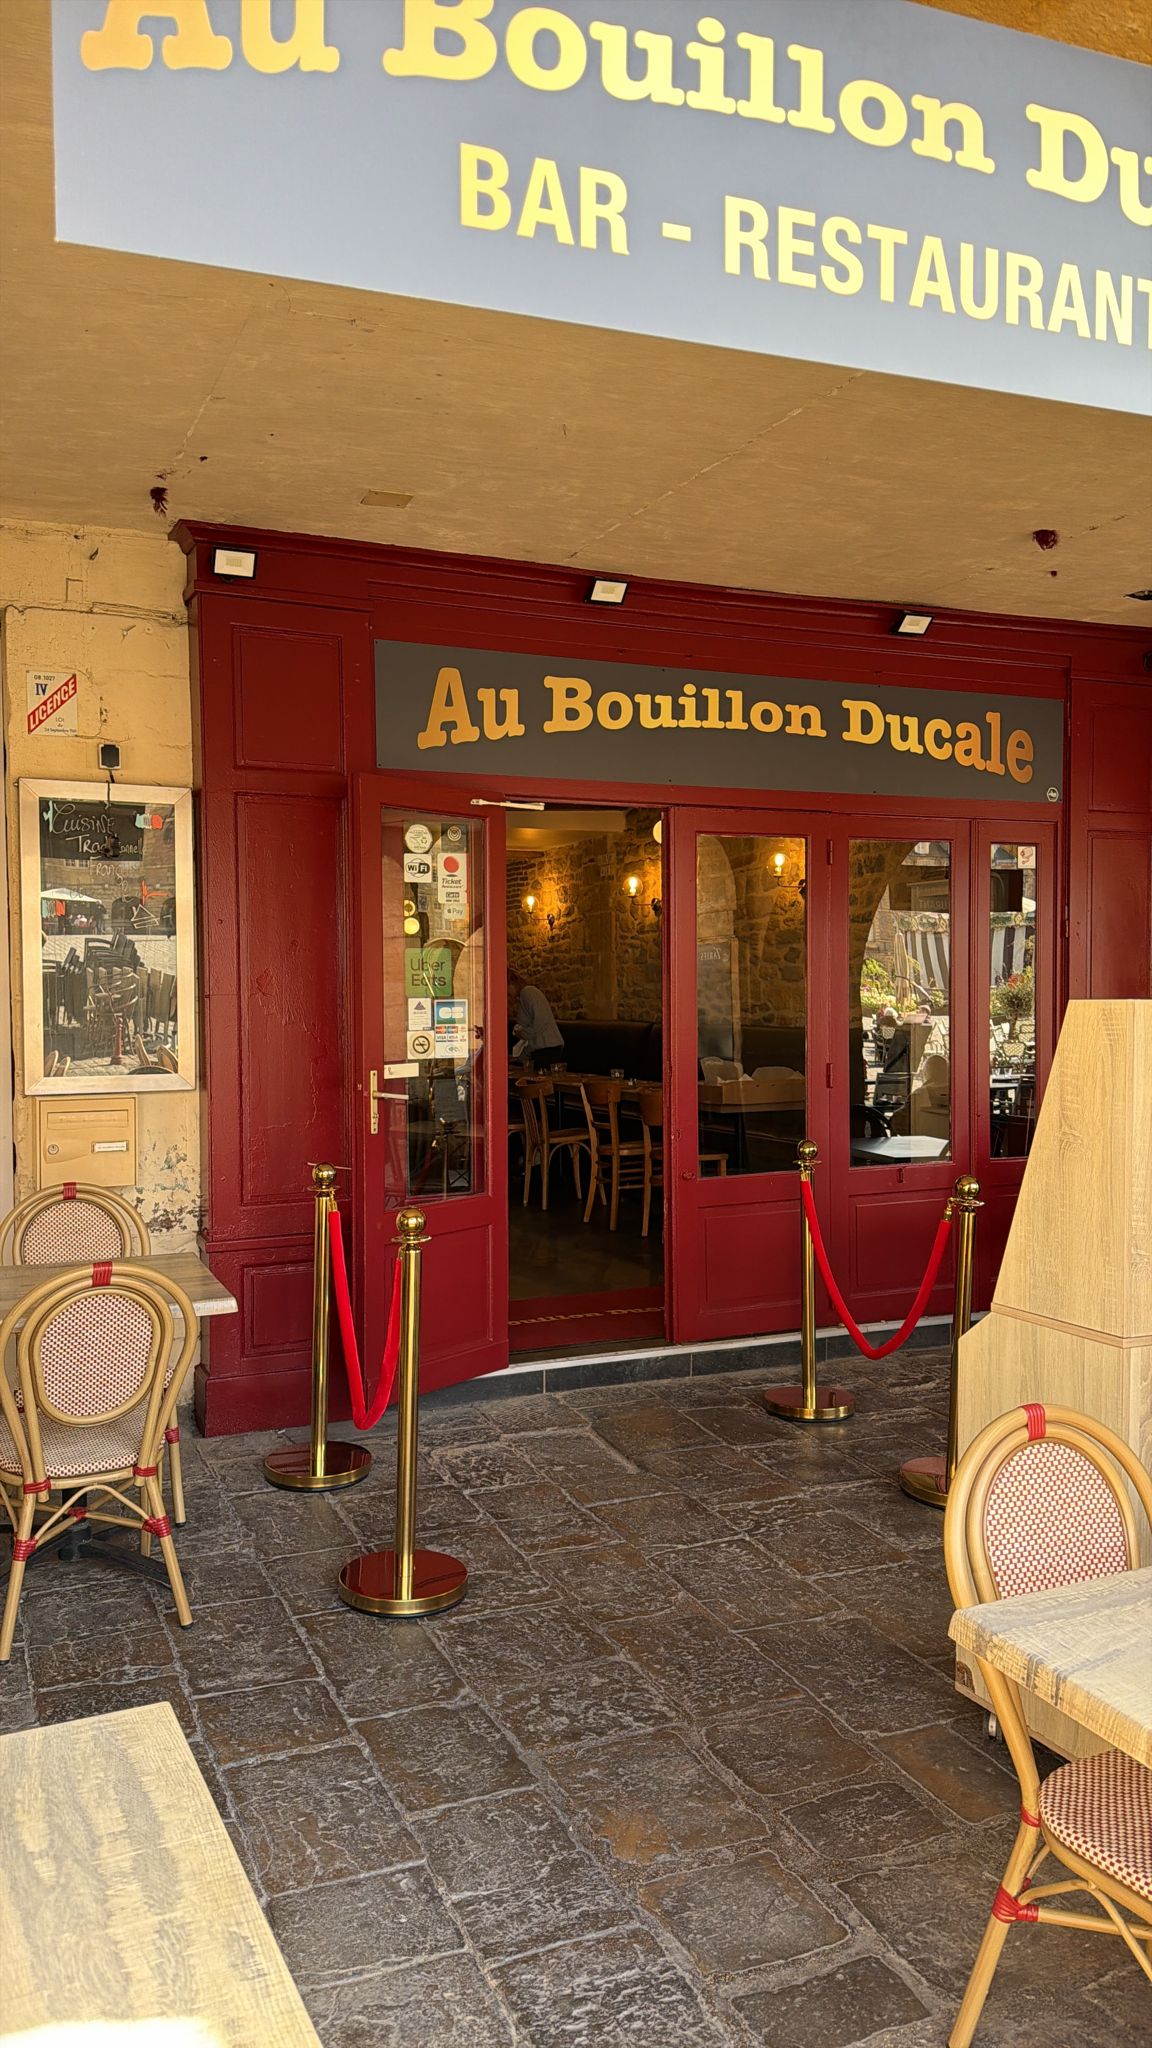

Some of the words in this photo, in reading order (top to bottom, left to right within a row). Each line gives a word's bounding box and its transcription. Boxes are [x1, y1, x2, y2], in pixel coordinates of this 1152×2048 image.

[382, 0, 995, 174] Bouillon
[460, 142, 629, 256] BAR
[29, 678, 75, 731] LICENCE
[35, 683, 48, 696] IV
[417, 667, 525, 750] Au
[543, 675, 827, 738] Bouillon
[842, 699, 1034, 784] Ducale
[410, 958, 445, 971] Uber
[411, 974, 447, 987] Eats
[508, 1312, 604, 1326] ouillon
